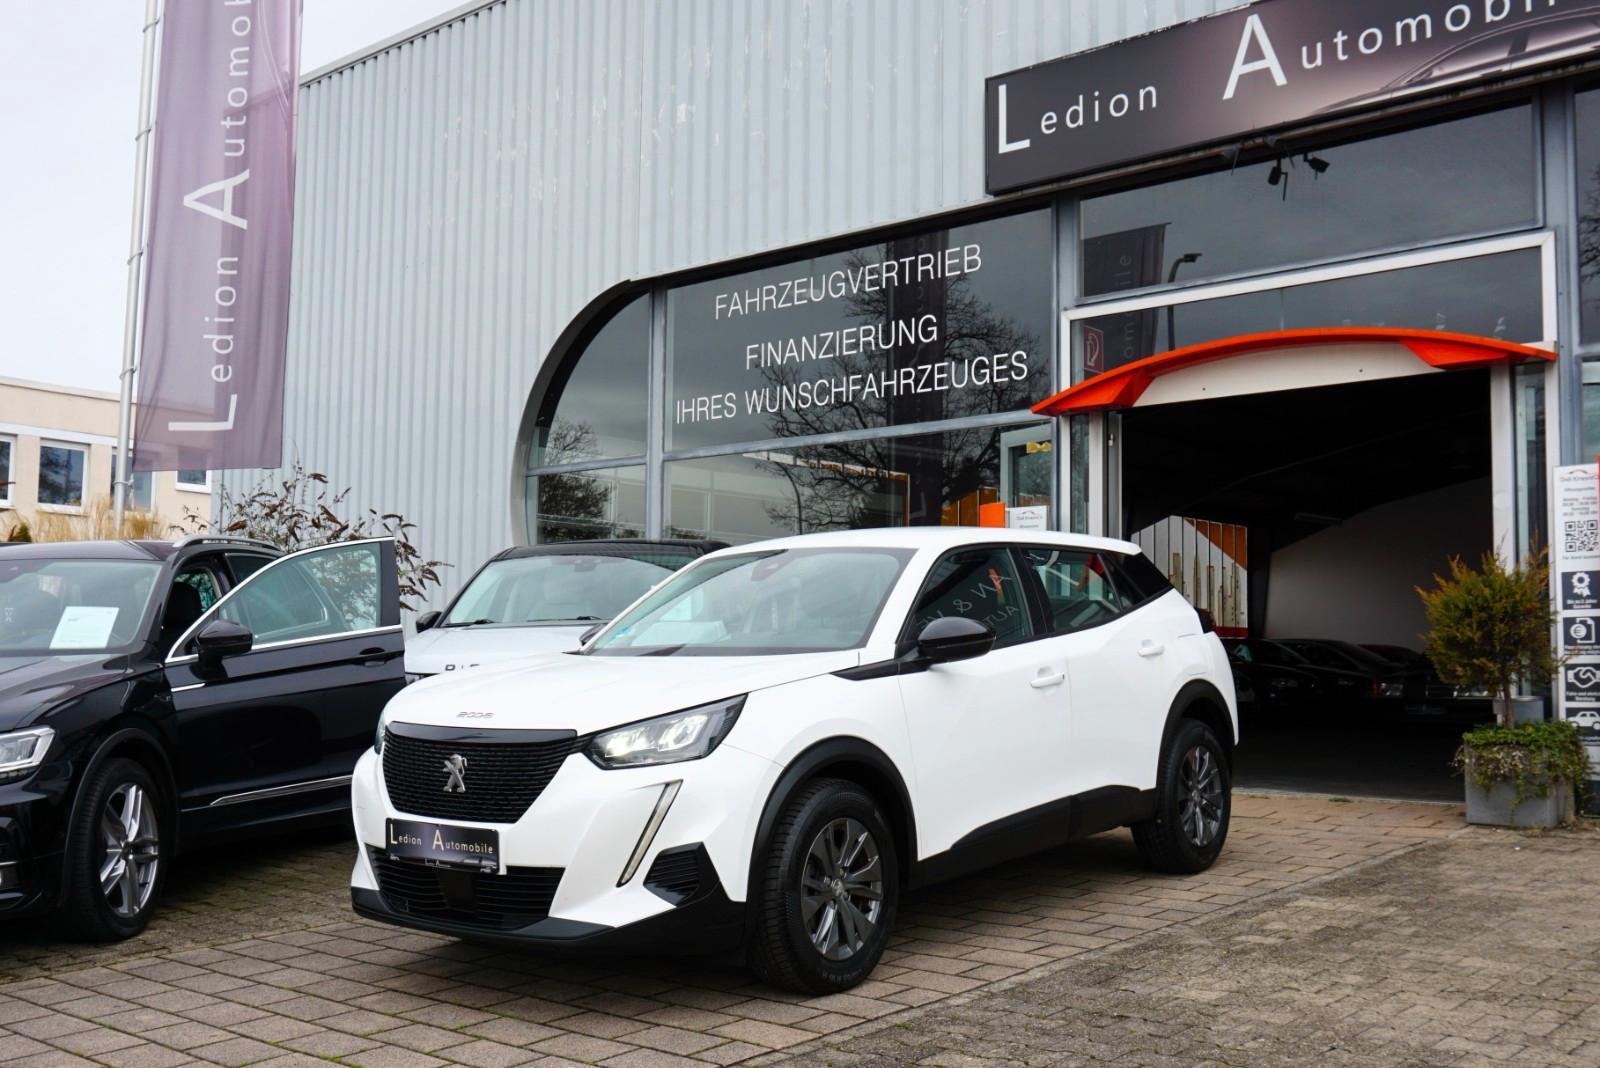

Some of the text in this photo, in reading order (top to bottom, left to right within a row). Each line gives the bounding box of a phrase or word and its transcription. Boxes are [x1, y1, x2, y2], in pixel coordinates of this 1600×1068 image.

[998, 0, 1556, 154] Ledion Automob
[714, 244, 982, 321] FAHRZEUGVERTRIEB
[168, 256, 239, 431] Ledion
[745, 314, 938, 371] FINANZIERUNG
[676, 350, 1028, 424] IHRES WUNSCHFAHRZEUGES
[389, 823, 494, 854] Ledion Automobile
